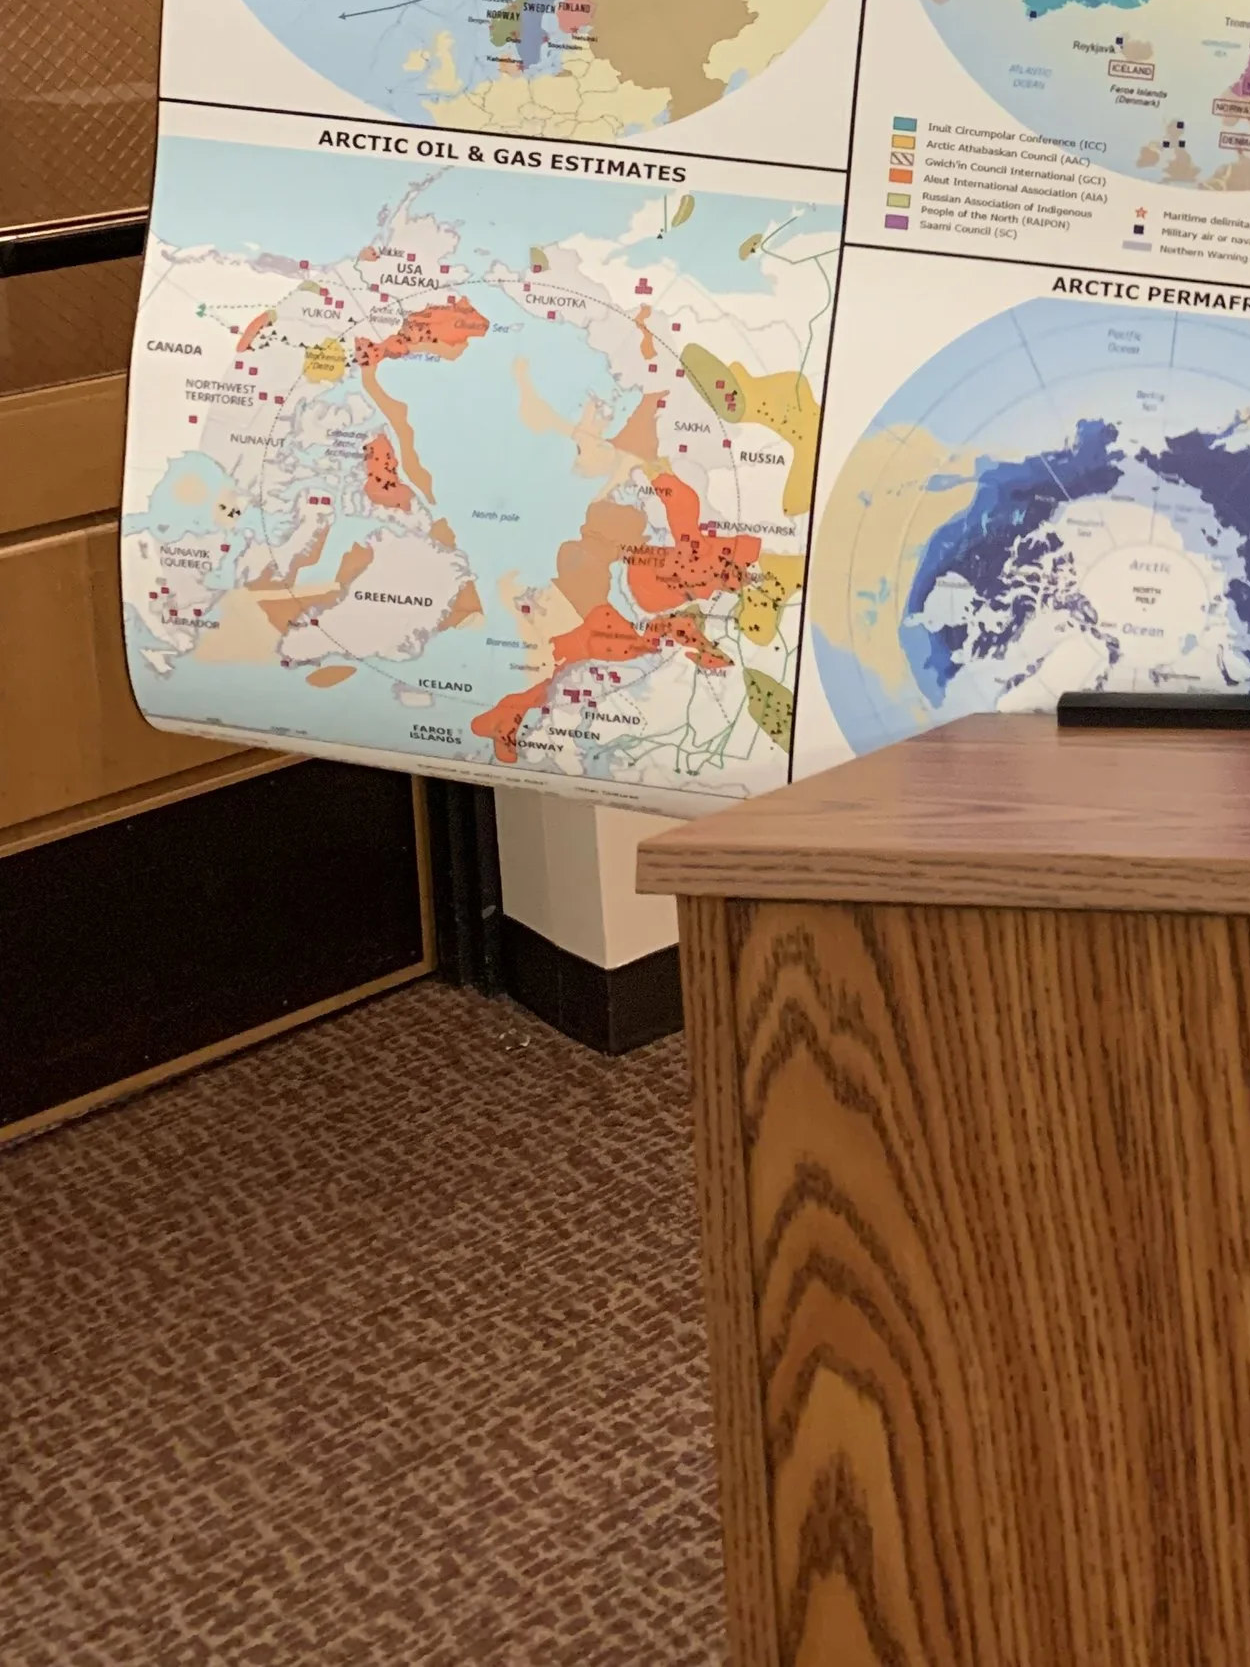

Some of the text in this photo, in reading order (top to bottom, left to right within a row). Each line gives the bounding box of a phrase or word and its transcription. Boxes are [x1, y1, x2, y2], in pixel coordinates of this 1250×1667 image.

[523, 1, 556, 14] SWEDEN
[558, 1, 591, 13] FINLAND
[486, 10, 520, 21] NORWAY
[1111, 65, 1152, 76] ICELAND
[1115, 95, 1160, 108] (Denmark)
[928, 122, 1107, 153] Inuit Circumpolar Conference (ICC)
[318, 130, 687, 184] ARCTIC OIL & GAS ESTIMATES
[926, 140, 1091, 168] Arctic Athabaskan Council (AAC)
[925, 158, 1107, 187] Gwich'in Council International (GCI)
[923, 174, 1108, 204] Aleut International Association (AIA)
[922, 192, 1092, 219] Russian Association of Indigenous
[921, 206, 1071, 231] People of the North (RAIPON)
[1163, 210, 1207, 224] Maritime
[920, 220, 1018, 240] Saami Council (SC)
[1161, 227, 1198, 241] Military
[1201, 232, 1214, 241] air
[1217, 234, 1228, 242] or
[1160, 245, 1204, 258] Northern
[1207, 250, 1248, 265] Warning
[397, 263, 423, 275] USA
[380, 273, 440, 290] (ALASKA)
[1052, 276, 1140, 300] ARCTIC
[526, 293, 587, 309] CHUKOTKA
[301, 307, 341, 320] YUKON
[147, 341, 202, 355] CANADA
[186, 379, 256, 394] NORTHWEST
[185, 391, 253, 407] TERRITORIES
[674, 421, 711, 434] SAKHA
[230, 434, 285, 447] NUNAVUT
[740, 451, 786, 467] RUSSIA
[471, 510, 520, 523] North pole
[716, 522, 796, 537] KRASNOYARSK
[160, 545, 210, 559] NUNAVIK
[1129, 559, 1171, 576] Arctic
[354, 590, 433, 607] GREENLAND
[161, 616, 220, 630] LABRADOR
[1122, 623, 1164, 637] Ocean
[418, 679, 473, 693] ICELAND
[584, 712, 641, 726] FINLAND
[413, 725, 452, 736] FAROE
[549, 727, 600, 741] SWEDEN
[409, 731, 462, 745] ISLANDS
[508, 737, 564, 752] NORWAY
